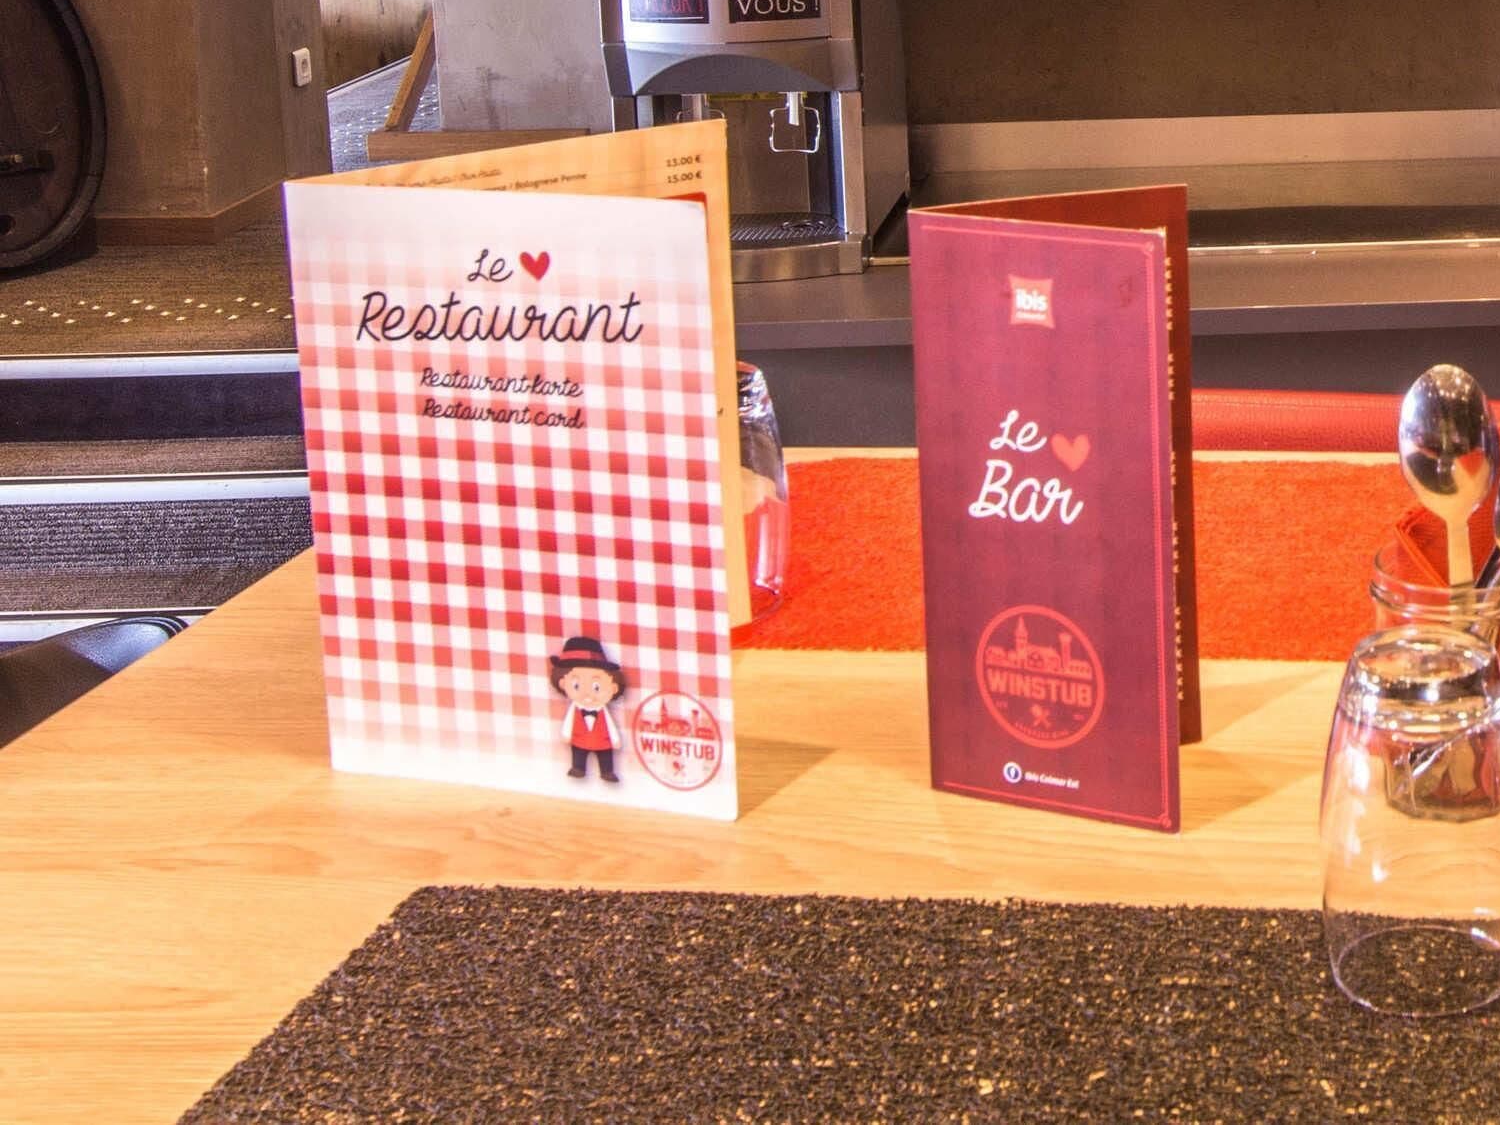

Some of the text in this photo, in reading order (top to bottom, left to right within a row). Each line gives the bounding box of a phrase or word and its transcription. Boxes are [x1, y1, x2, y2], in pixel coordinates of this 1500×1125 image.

[466, 248, 514, 283] Le
[356, 290, 645, 343] Restaurant
[1015, 287, 1048, 312] ibis
[421, 397, 586, 429] Restaurant card
[989, 408, 1047, 455] Le
[967, 457, 1085, 526] Bar
[985, 667, 1094, 708] WINSTUB
[640, 735, 716, 762] WINSTUB
